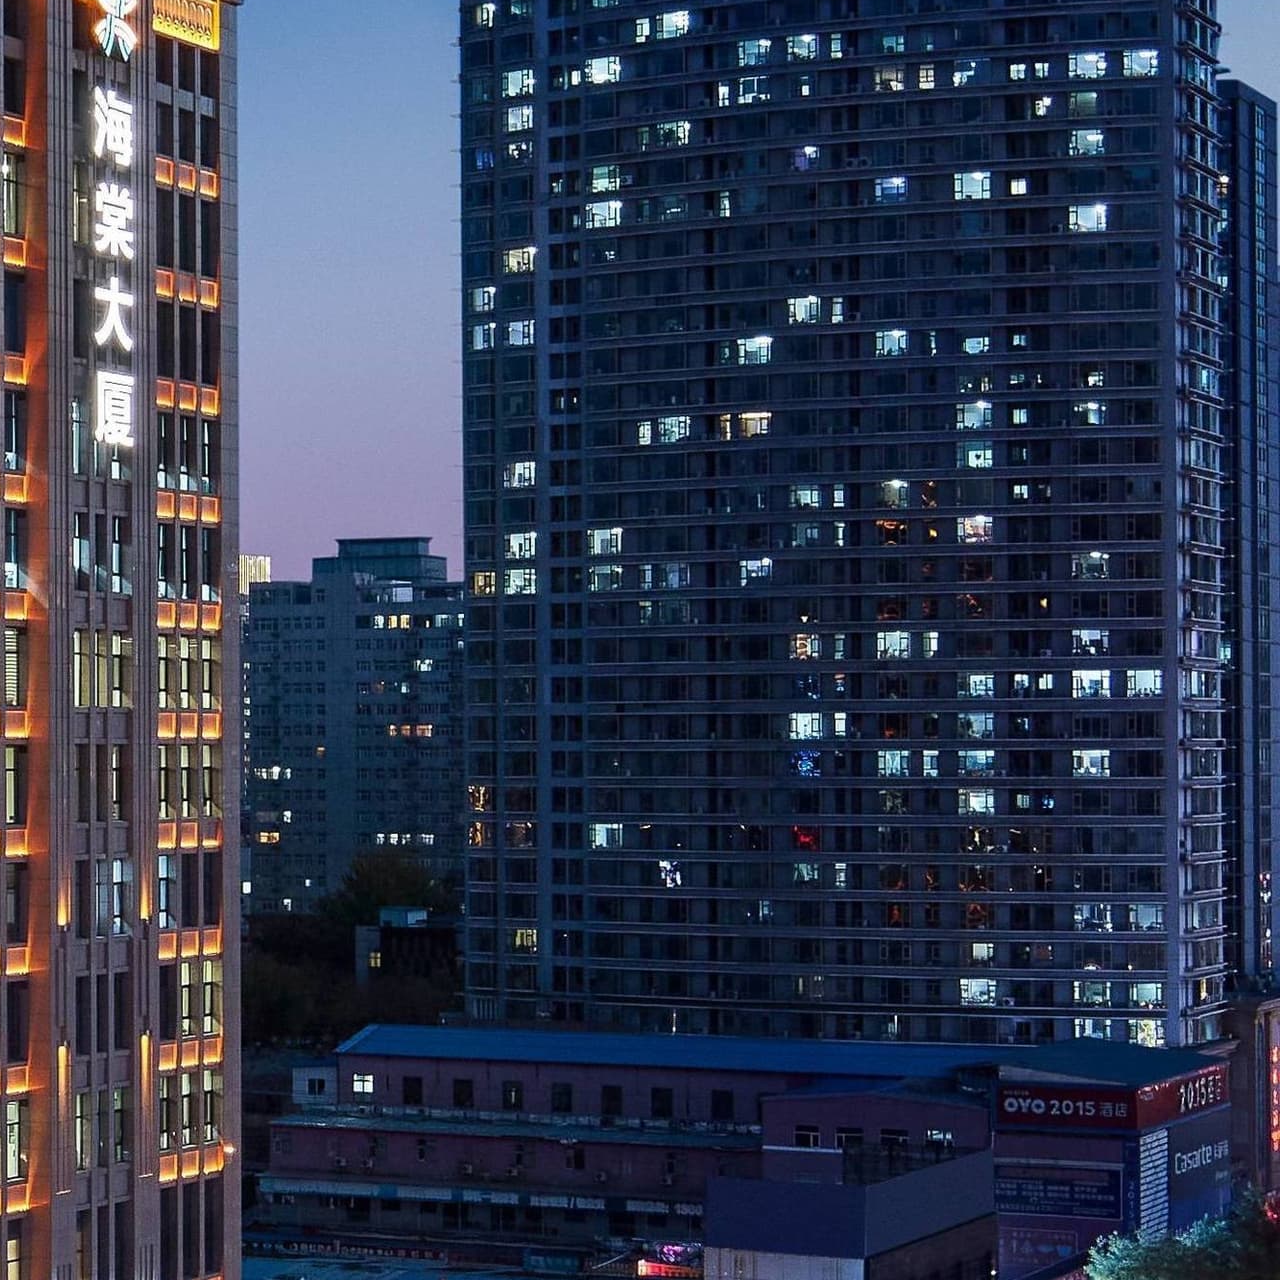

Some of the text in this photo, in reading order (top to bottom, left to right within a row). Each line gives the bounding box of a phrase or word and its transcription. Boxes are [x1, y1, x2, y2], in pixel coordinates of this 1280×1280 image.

[93, 85, 134, 447] 海棠大厦
[1003, 1097, 1046, 1114] OYO
[1049, 1099, 1096, 1117] 2015
[1175, 1144, 1213, 1175] Casarte
